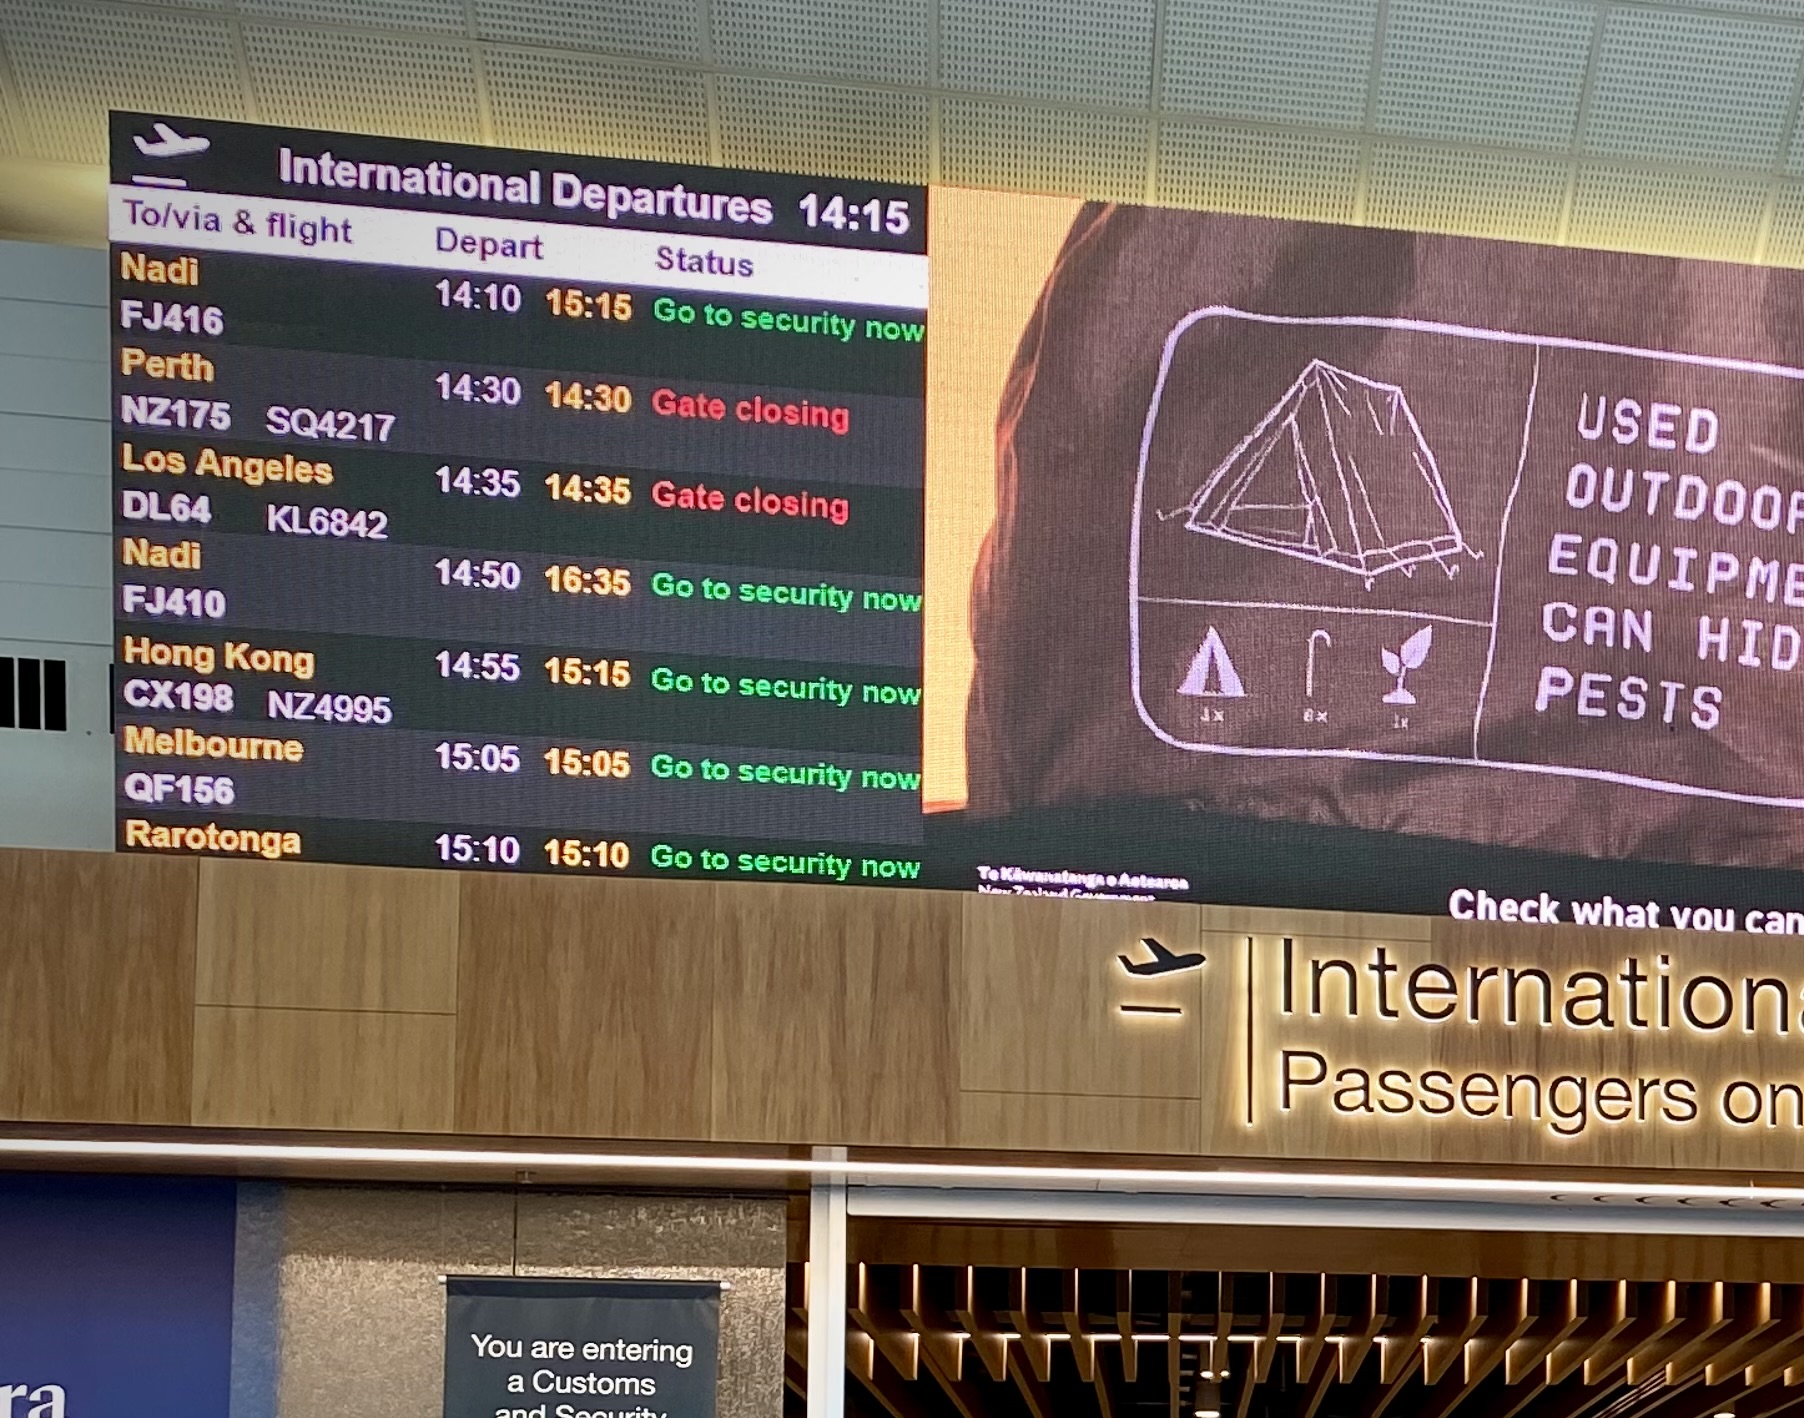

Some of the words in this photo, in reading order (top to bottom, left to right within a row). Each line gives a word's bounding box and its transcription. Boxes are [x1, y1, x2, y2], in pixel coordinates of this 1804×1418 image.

[278, 146, 541, 205] International
[552, 171, 775, 225] Departures
[798, 194, 911, 236] 14:15
[126, 198, 222, 234] To/via
[233, 209, 254, 236] &
[265, 212, 354, 247] flight
[435, 227, 545, 261] Depart
[655, 246, 755, 278] Status
[120, 252, 200, 286] Nadi
[120, 299, 223, 336] FJ416
[435, 278, 522, 312] 14:10
[545, 288, 633, 320] 15:15
[652, 295, 695, 324] Go
[704, 299, 733, 326] to
[740, 302, 858, 341] security
[864, 314, 925, 343] now
[120, 349, 215, 383] Perth
[435, 370, 522, 405] 14:30
[545, 380, 633, 413] 14:30
[650, 388, 725, 421] Gate
[733, 395, 851, 434] closing
[122, 395, 232, 431] NZ175
[265, 405, 395, 442] SQ4217
[1577, 391, 1719, 454] USED
[122, 441, 187, 475] Los
[195, 449, 333, 487] Angeles
[435, 464, 522, 497] 14:35
[544, 474, 631, 506] 14:35
[122, 488, 212, 523] DL64
[267, 502, 388, 539] KL6842
[122, 536, 202, 570] Nadi
[435, 556, 522, 589] 14:50
[544, 564, 631, 596] 16:35
[122, 584, 226, 619] FJ410
[1542, 601, 1655, 654] CAN
[123, 635, 215, 675] Hong
[224, 642, 315, 679] Kong
[435, 647, 522, 682] 14:55
[544, 657, 631, 688] 15:15
[123, 677, 235, 712] CX198
[267, 688, 392, 724] NZ4995
[1535, 665, 1722, 730] PESTS
[123, 725, 304, 764] Melbourne
[123, 771, 235, 807] QF156
[123, 817, 302, 858] Rarotonga
[1447, 887, 1560, 924] Check
[1571, 895, 1660, 930] what
[1670, 905, 1736, 932] you
[1278, 1046, 1699, 1137] Passengers
[471, 1332, 522, 1360] You
[530, 1337, 575, 1360] are
[581, 1336, 694, 1368] entering
[507, 1374, 525, 1393] a
[531, 1367, 656, 1396] Customs
